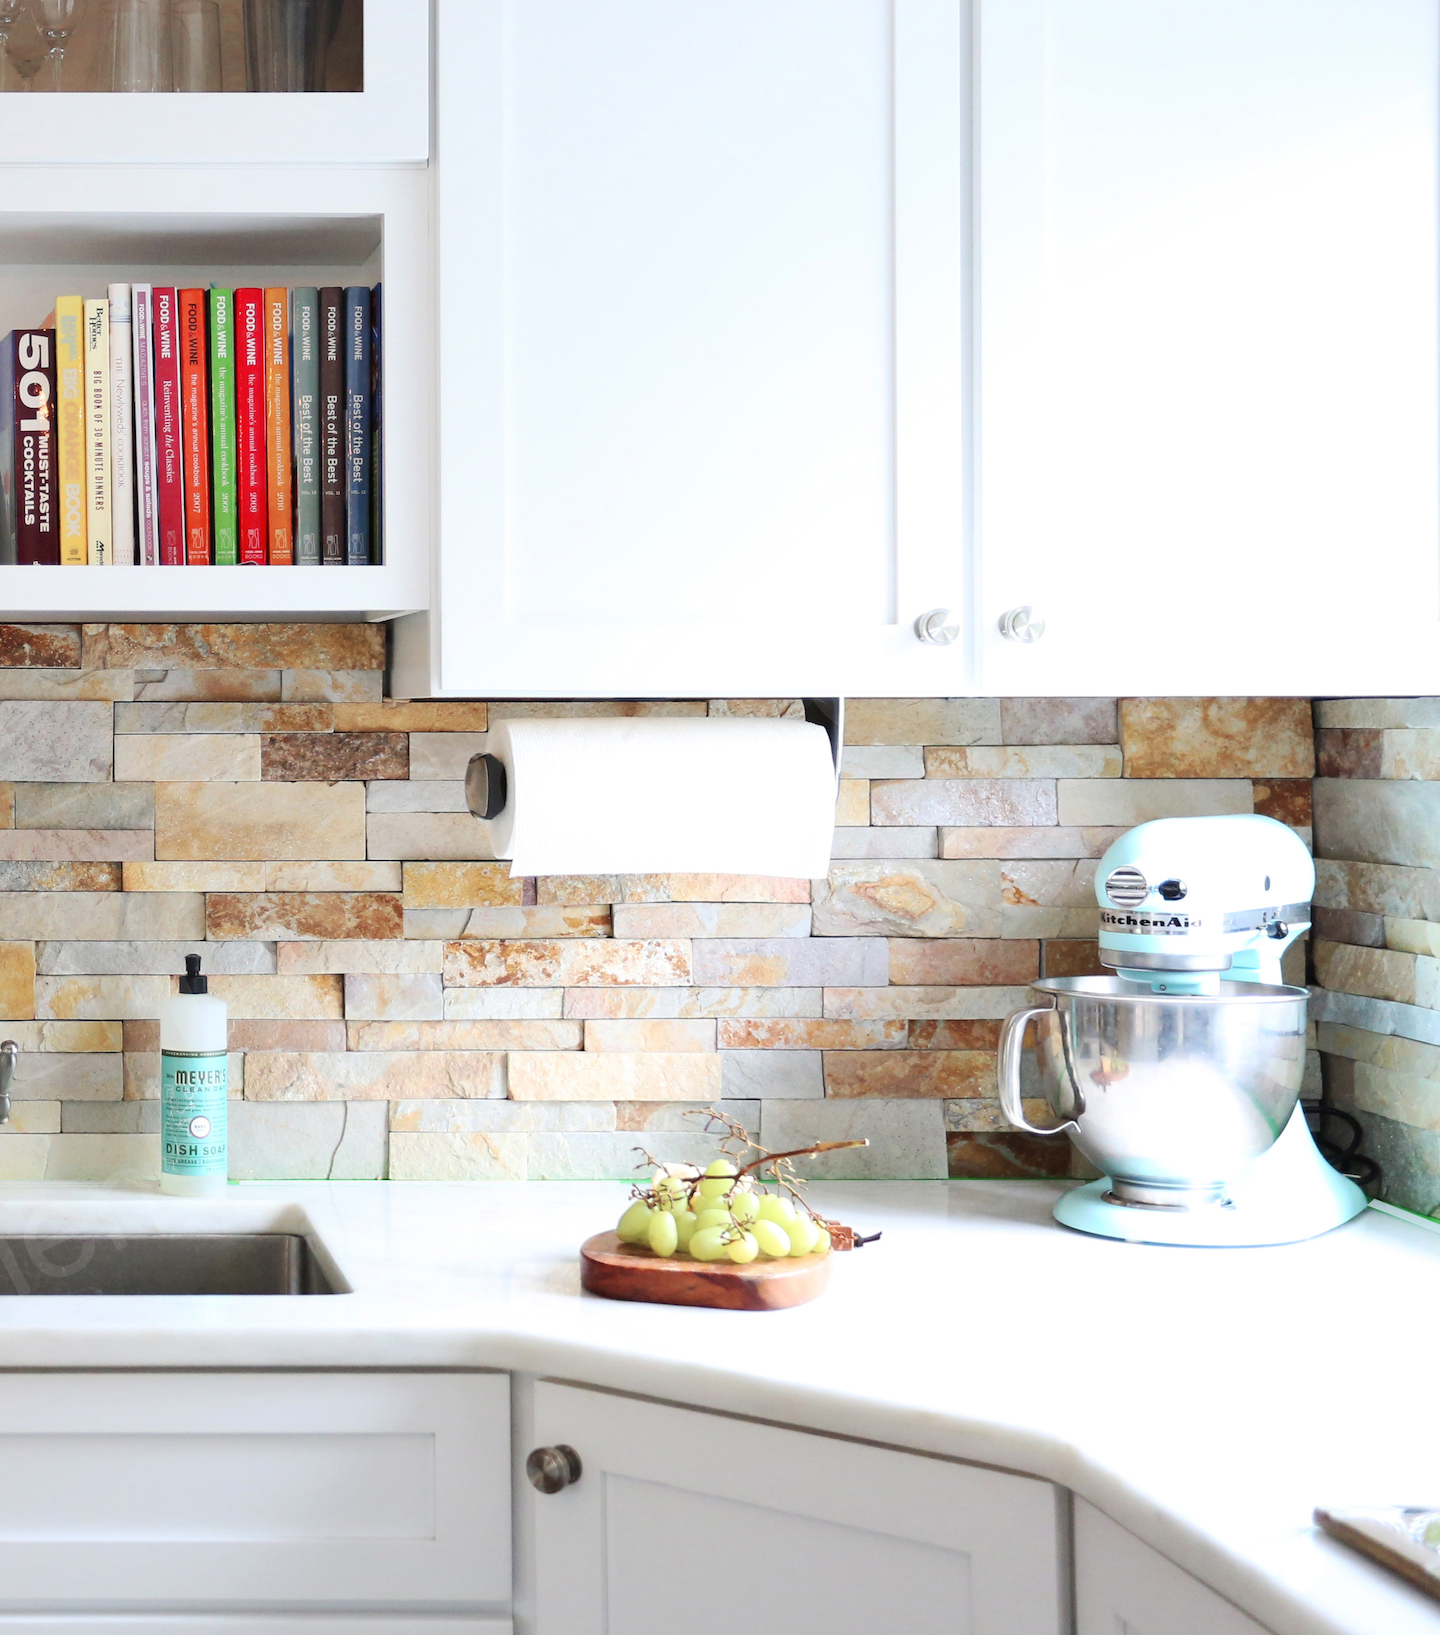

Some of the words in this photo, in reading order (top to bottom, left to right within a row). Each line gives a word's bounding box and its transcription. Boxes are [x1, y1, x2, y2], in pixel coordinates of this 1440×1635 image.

[89, 317, 97, 350] Homes
[160, 295, 170, 358] FOOD&WINE
[188, 303, 198, 365] FOOD&WINE
[217, 296, 227, 358] FOOD&WINE
[246, 303, 256, 365] FOOD&WINE
[273, 303, 282, 365] FOOD&WINE
[302, 306, 310, 360] FOOD&WINE
[327, 307, 336, 361] FOOD&WINE
[354, 306, 362, 360] FOOD&WINE
[18, 333, 51, 432] 501
[63, 369, 78, 398] BIG
[93, 371, 102, 384] BIG
[219, 367, 227, 379] the
[94, 389, 102, 409] BOOK
[163, 380, 174, 432] Reinventing
[190, 387, 199, 426] magazine's
[218, 381, 228, 421] magazine's
[247, 387, 256, 425] magazine's
[274, 387, 283, 425] magazine's
[302, 395, 312, 420] Best
[327, 395, 338, 420] Best
[353, 395, 363, 419] Best
[94, 414, 103, 423] OF
[303, 423, 313, 434] of
[327, 423, 338, 434] of
[353, 423, 363, 433] of
[64, 402, 80, 480] ORANGE
[165, 435, 174, 448] the
[220, 423, 228, 448] annual
[249, 427, 257, 451] annual
[303, 437, 312, 454] the
[328, 437, 337, 455] the
[353, 437, 362, 454] the
[94, 428, 103, 471] 30-MINUTE
[117, 439, 125, 488] COOKBOOK
[165, 449, 175, 483] Classics
[221, 451, 229, 486] cookbook
[276, 453, 284, 486] cookbook
[303, 458, 313, 483] Best
[328, 458, 338, 483] Best
[353, 458, 363, 482] Best
[24, 436, 35, 526] COCKTAILS
[39, 435, 49, 532] MUST-TASTE
[95, 476, 104, 510] DINNERS
[65, 484, 81, 538] BOOK
[193, 493, 201, 513] 2007
[221, 492, 229, 513] 2008
[249, 492, 257, 513] 2009
[276, 492, 284, 510] 2010
[1100, 910, 1202, 929] KitchenAid
[175, 1068, 226, 1085] MEYER'S
[166, 1143, 198, 1155] DISH
[202, 1145, 226, 1156] SOAP
